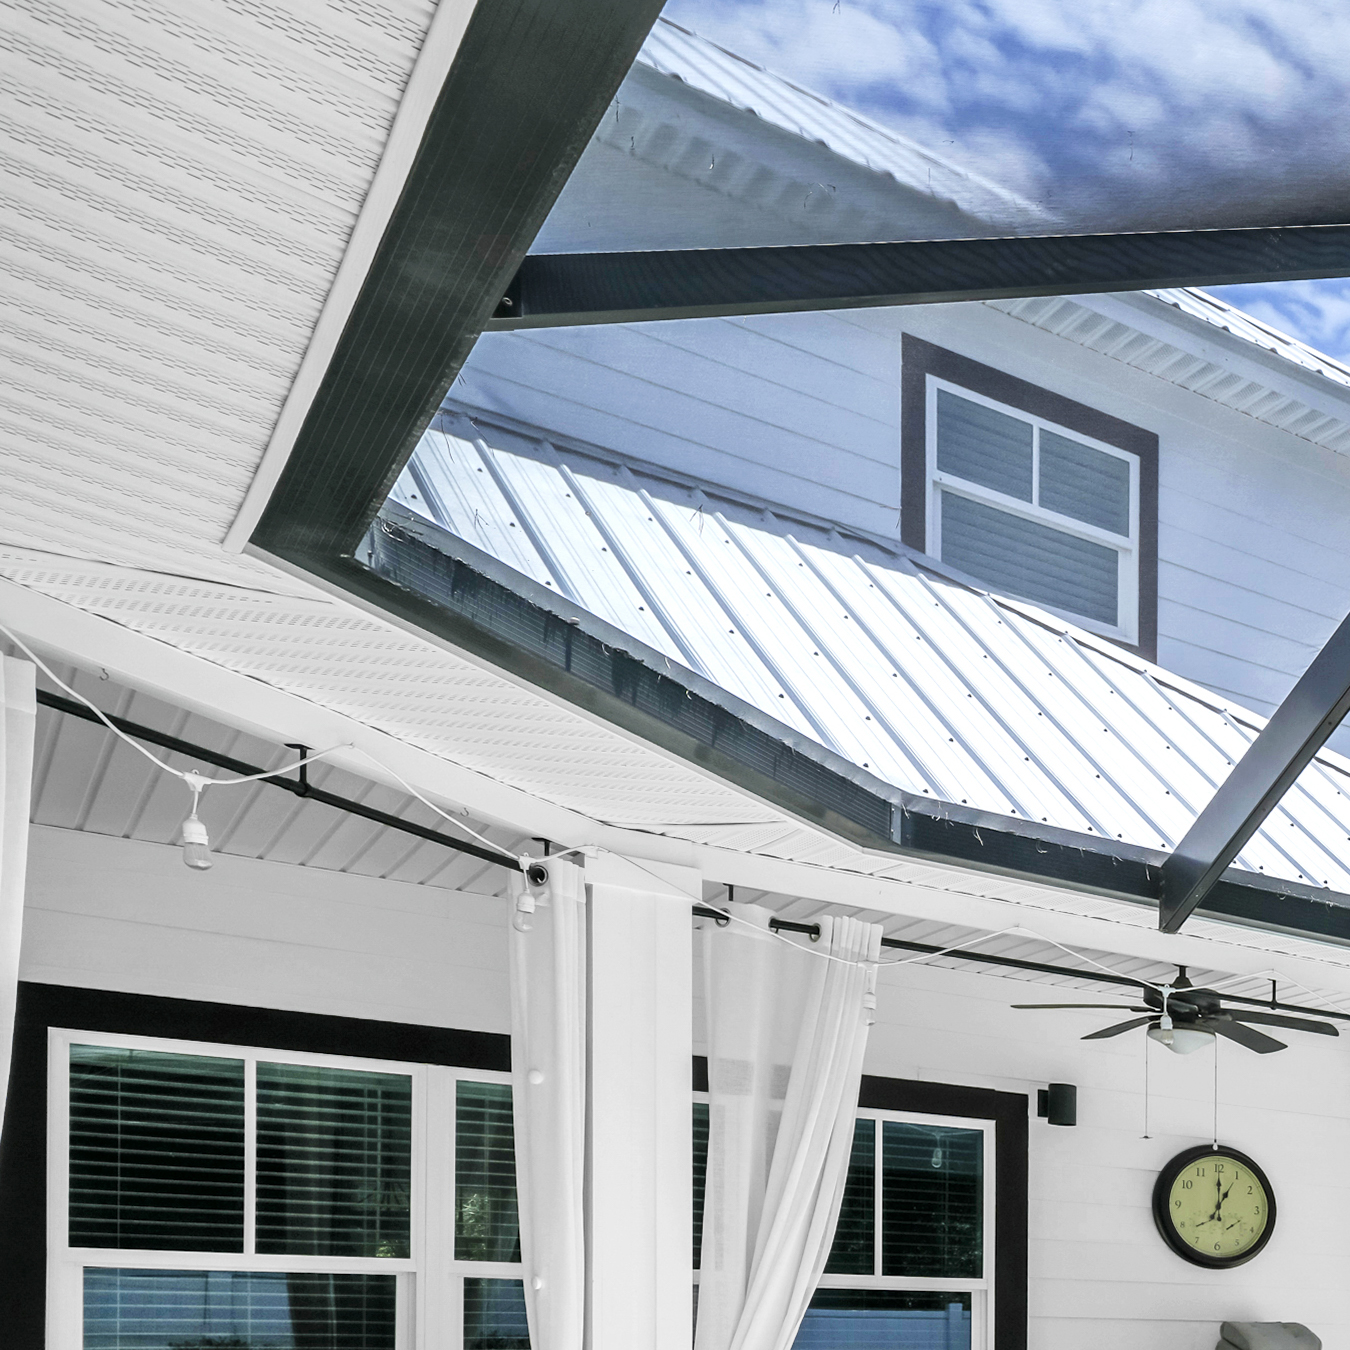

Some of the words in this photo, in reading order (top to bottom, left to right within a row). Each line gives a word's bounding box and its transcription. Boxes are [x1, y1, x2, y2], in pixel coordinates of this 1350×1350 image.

[1196, 1167, 1205, 1177] 11
[1214, 1163, 1224, 1173] 12
[1235, 1171, 1239, 1180] 1
[1181, 1179, 1193, 1189] 10
[1247, 1185, 1253, 1195] 2
[1175, 1200, 1182, 1209] 9
[1254, 1206, 1260, 1215] 3
[1195, 1236, 1200, 1244] 7
[1214, 1241, 1221, 1251] 6
